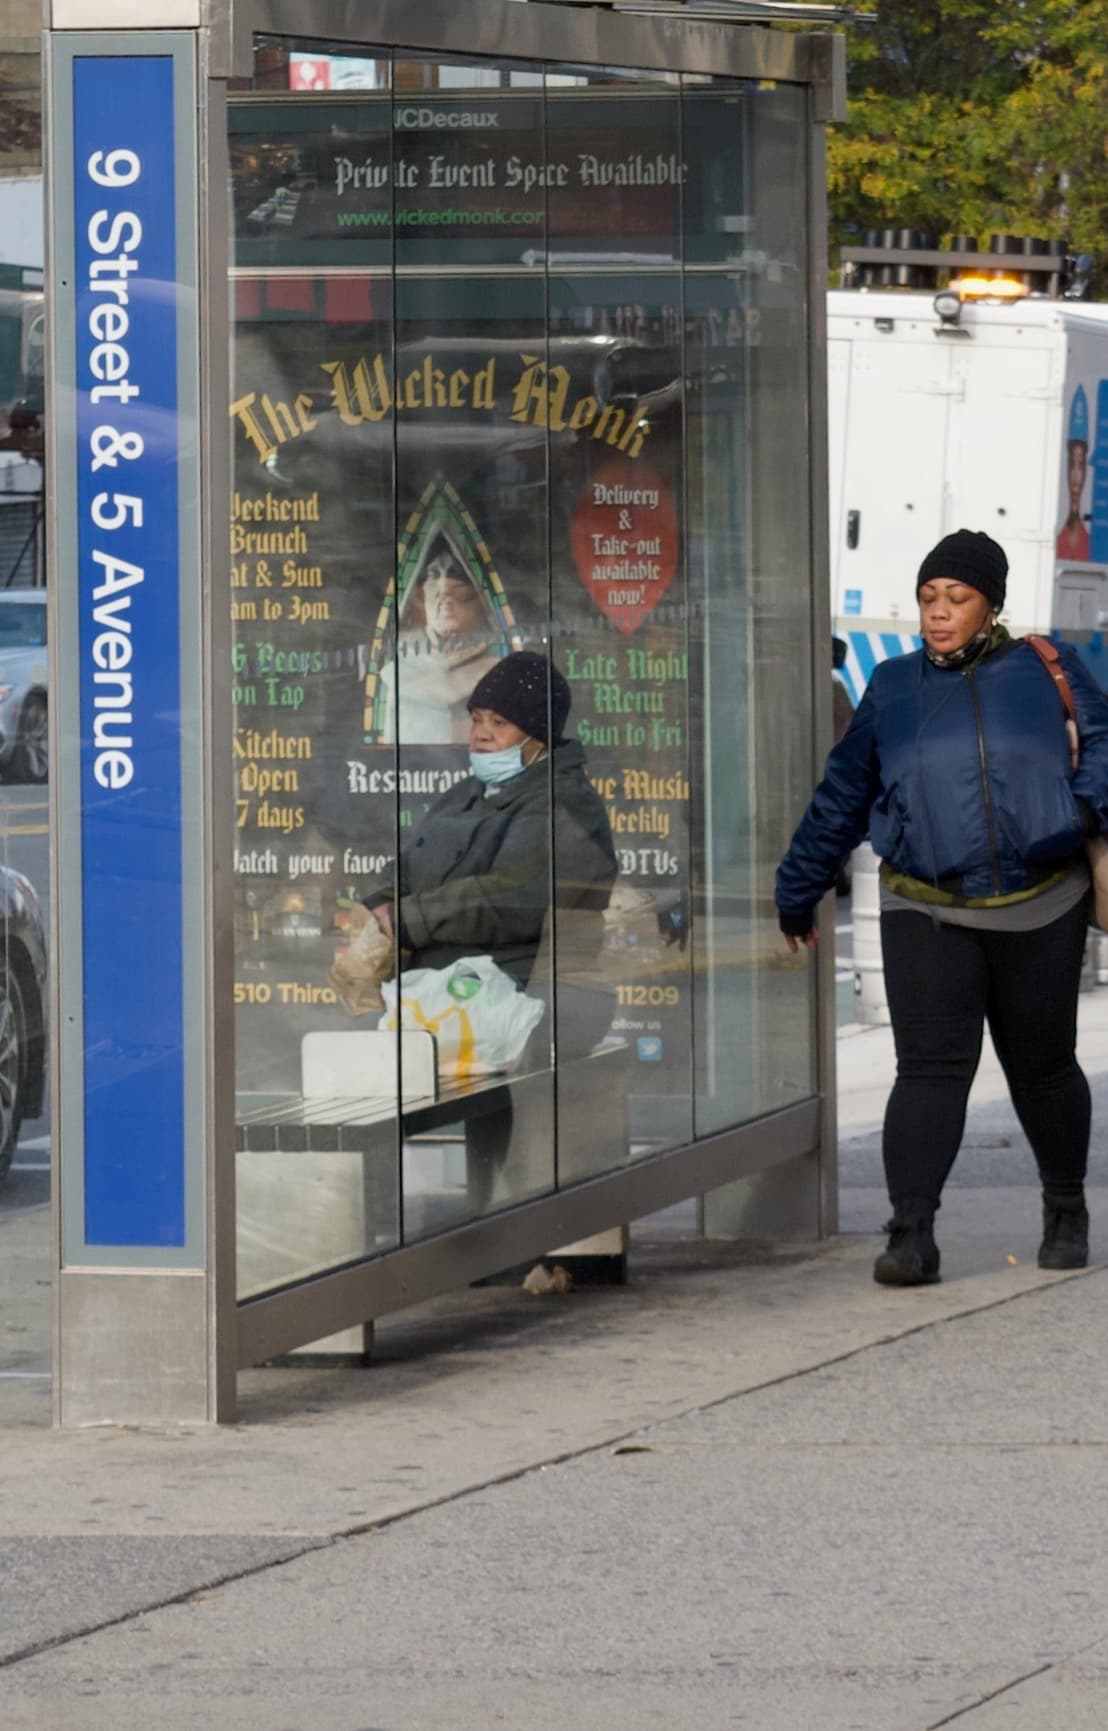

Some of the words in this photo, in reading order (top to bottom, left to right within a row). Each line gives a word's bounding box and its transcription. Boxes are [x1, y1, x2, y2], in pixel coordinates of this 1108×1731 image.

[393, 108, 498, 128] JCDecaux
[87, 148, 141, 188] 9
[334, 156, 419, 195] Privte
[428, 155, 496, 188] Event
[578, 153, 688, 187] Available
[87, 209, 143, 404] Street
[229, 391, 318, 464] The
[508, 353, 651, 459] Monk
[90, 424, 144, 472] &
[91, 491, 143, 531] 5
[592, 484, 659, 509] Delivery
[618, 508, 632, 530] &
[230, 524, 308, 554] Brunch
[592, 533, 661, 555] Take-out
[255, 560, 273, 588] &
[281, 560, 323, 588] Sun
[592, 560, 661, 581] available
[263, 597, 283, 620] to
[288, 595, 330, 625] 3pm
[607, 584, 646, 606] now!
[91, 549, 145, 790] Avenue
[565, 650, 617, 681] Late
[232, 684, 257, 706] on
[264, 677, 305, 712] Tap
[594, 683, 664, 713] Menu
[577, 718, 620, 747] Sun
[626, 718, 647, 747] to
[652, 718, 682, 752] Fri
[241, 761, 299, 797] Open
[234, 799, 251, 829] 7
[257, 800, 304, 835] days
[288, 854, 335, 880] your
[343, 847, 395, 875] favo
[616, 849, 679, 876] DTVs
[616, 984, 680, 1006] 11209
[647, 1018, 661, 1031] us
